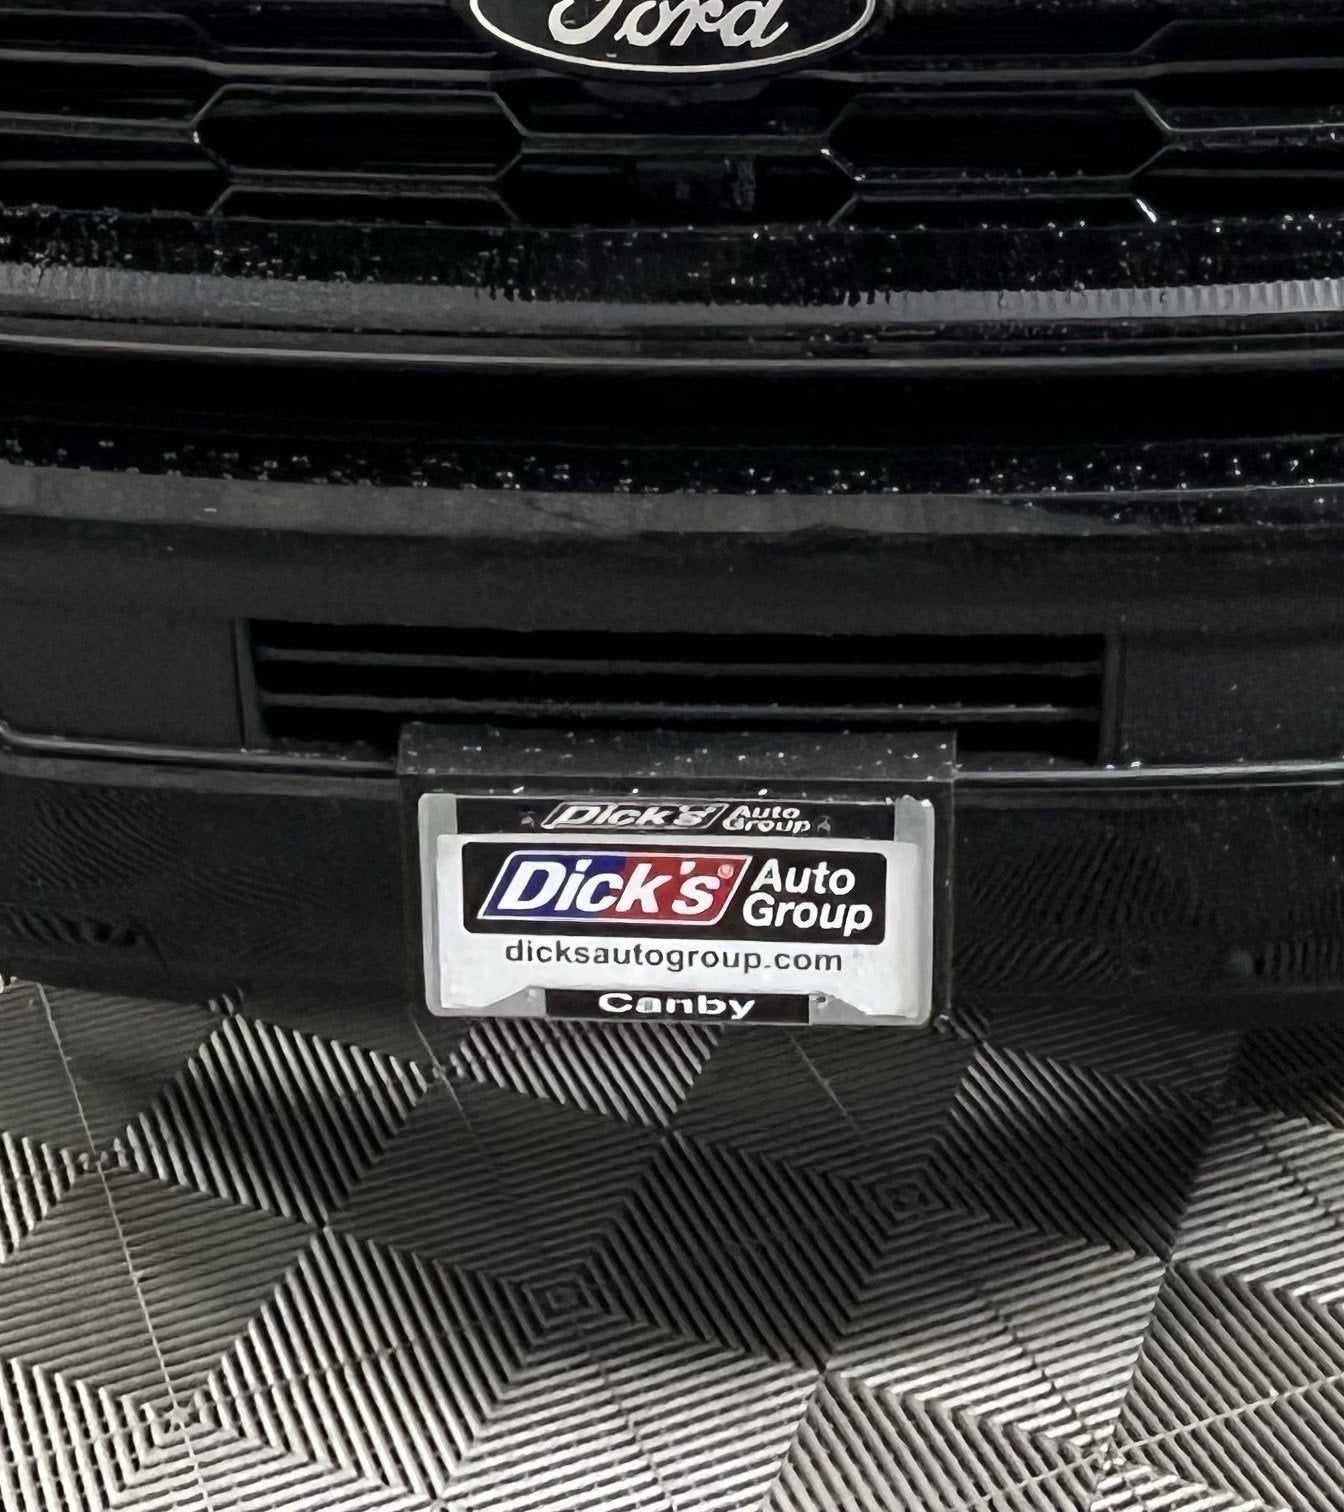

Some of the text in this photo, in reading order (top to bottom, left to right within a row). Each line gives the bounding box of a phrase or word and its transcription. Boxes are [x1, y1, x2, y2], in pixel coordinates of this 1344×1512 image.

[722, 816, 811, 834] Group
[732, 805, 801, 819] Auto
[497, 858, 721, 915] Dick's
[750, 858, 856, 896] Auto
[742, 893, 874, 937] Group
[505, 939, 843, 974] dicksautogroup.com
[598, 992, 755, 1021] Canby
